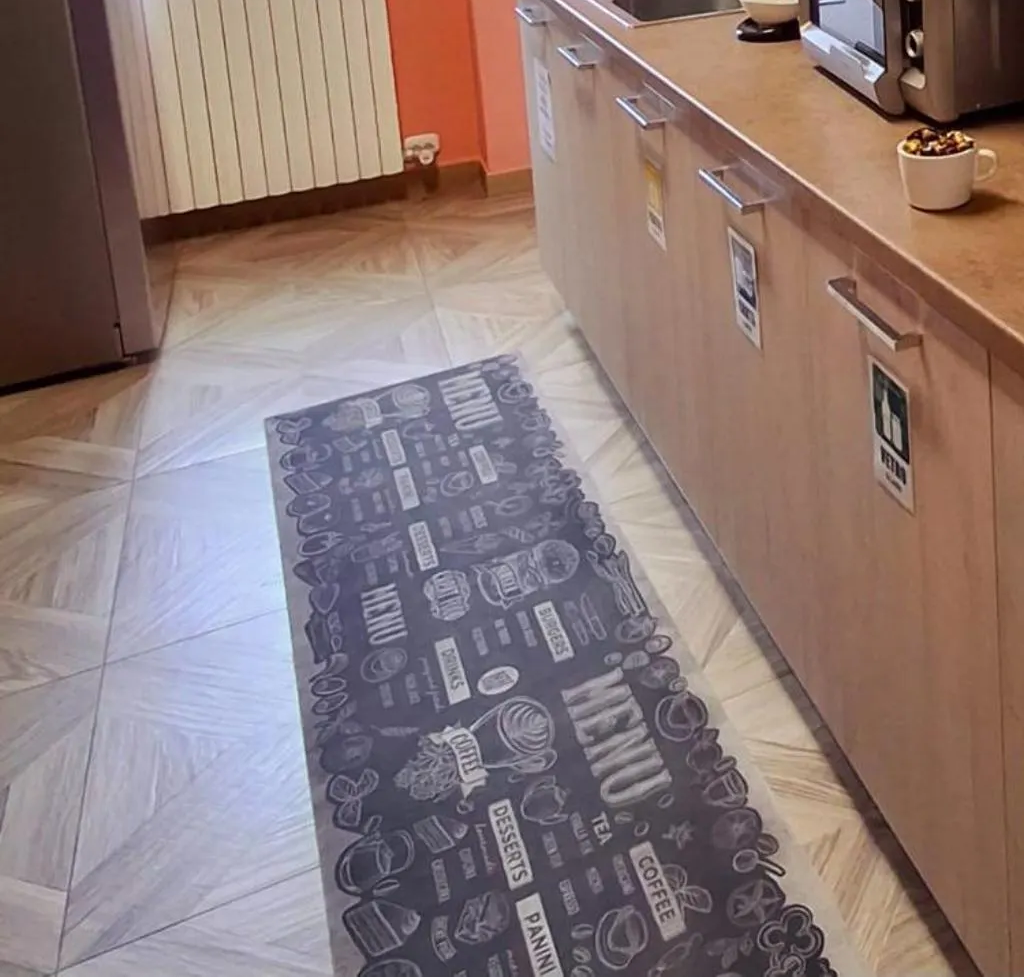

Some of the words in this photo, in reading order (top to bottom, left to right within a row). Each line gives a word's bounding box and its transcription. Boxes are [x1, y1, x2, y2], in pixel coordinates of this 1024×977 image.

[438, 370, 503, 430] MENU
[361, 582, 408, 646] MENU
[538, 607, 570, 655] BURGERS
[441, 648, 465, 690] DRINKS
[450, 734, 479, 775] COFFEE
[560, 666, 672, 806] MENU
[493, 806, 528, 883] DESSERTS
[592, 811, 613, 846] TEA
[638, 856, 676, 923] COFFEE
[524, 911, 557, 977] PANINI
